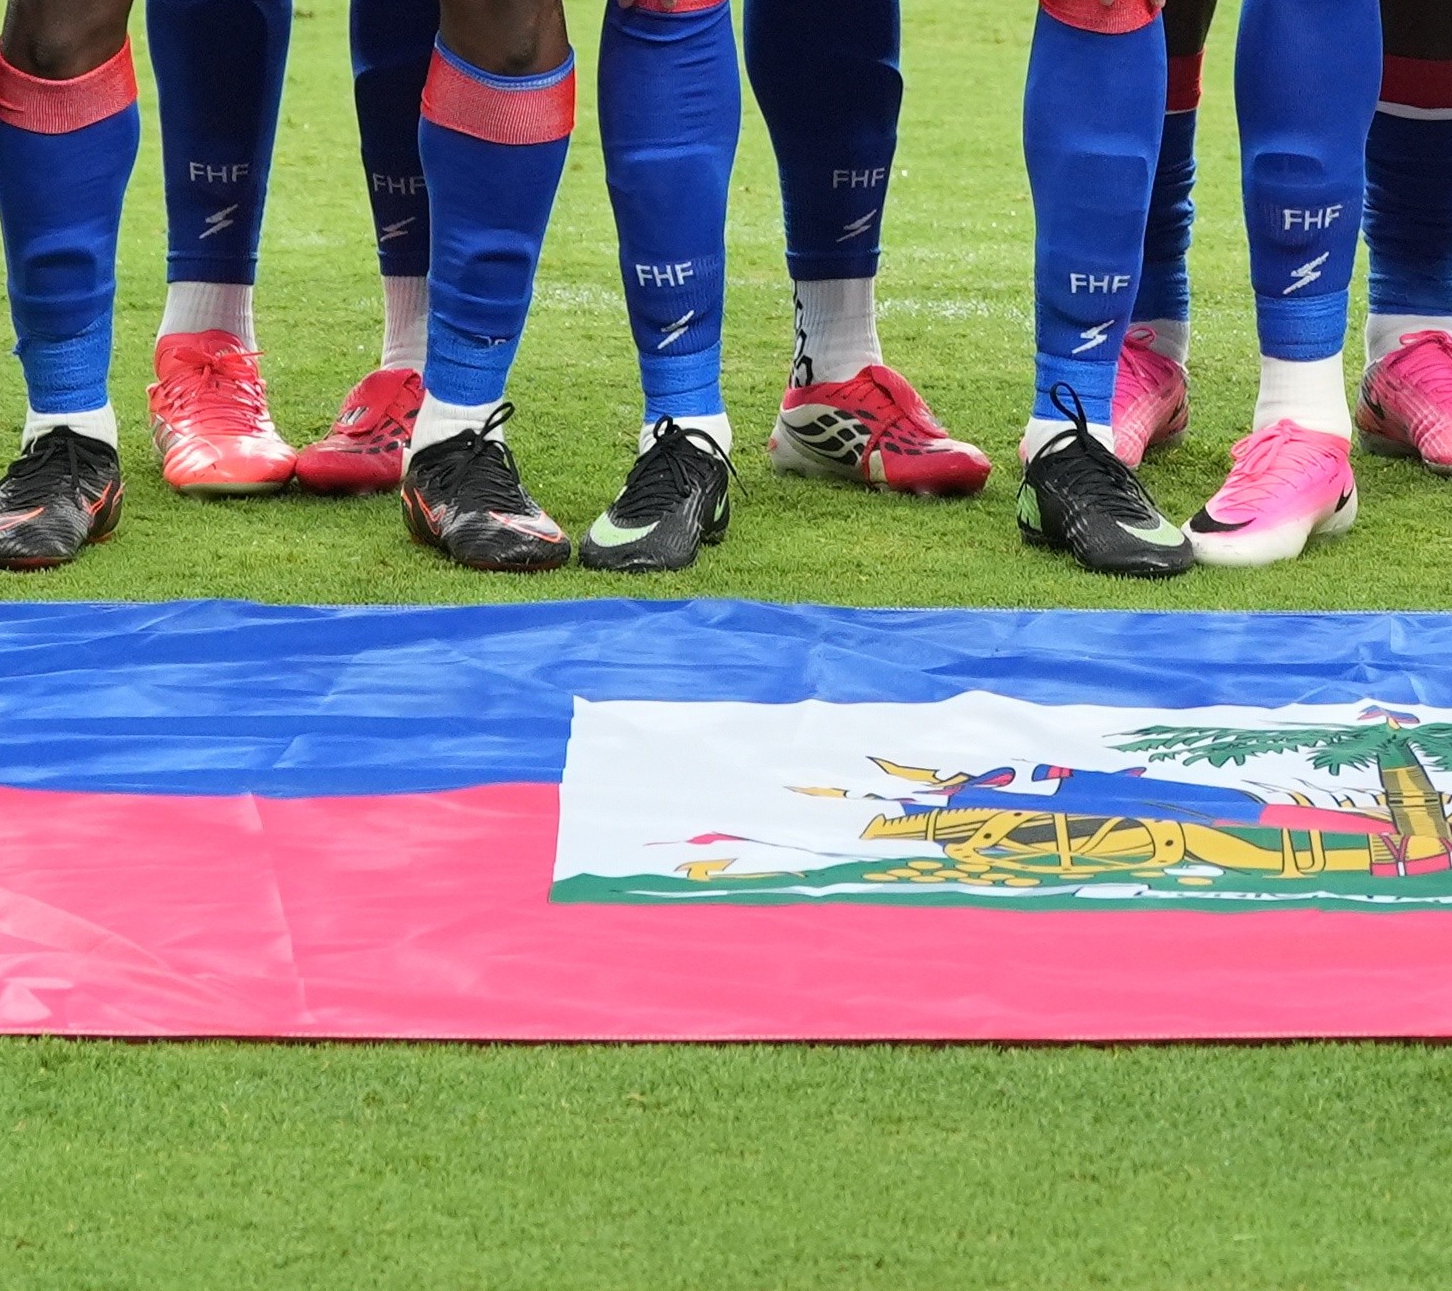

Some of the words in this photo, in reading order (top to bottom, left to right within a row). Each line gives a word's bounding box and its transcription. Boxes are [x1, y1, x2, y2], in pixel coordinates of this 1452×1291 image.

[189, 162, 248, 183] FHF
[832, 167, 885, 188] FHF
[1283, 204, 1343, 231] FHF
[636, 262, 694, 287] FHF
[1070, 273, 1131, 294] FHF
